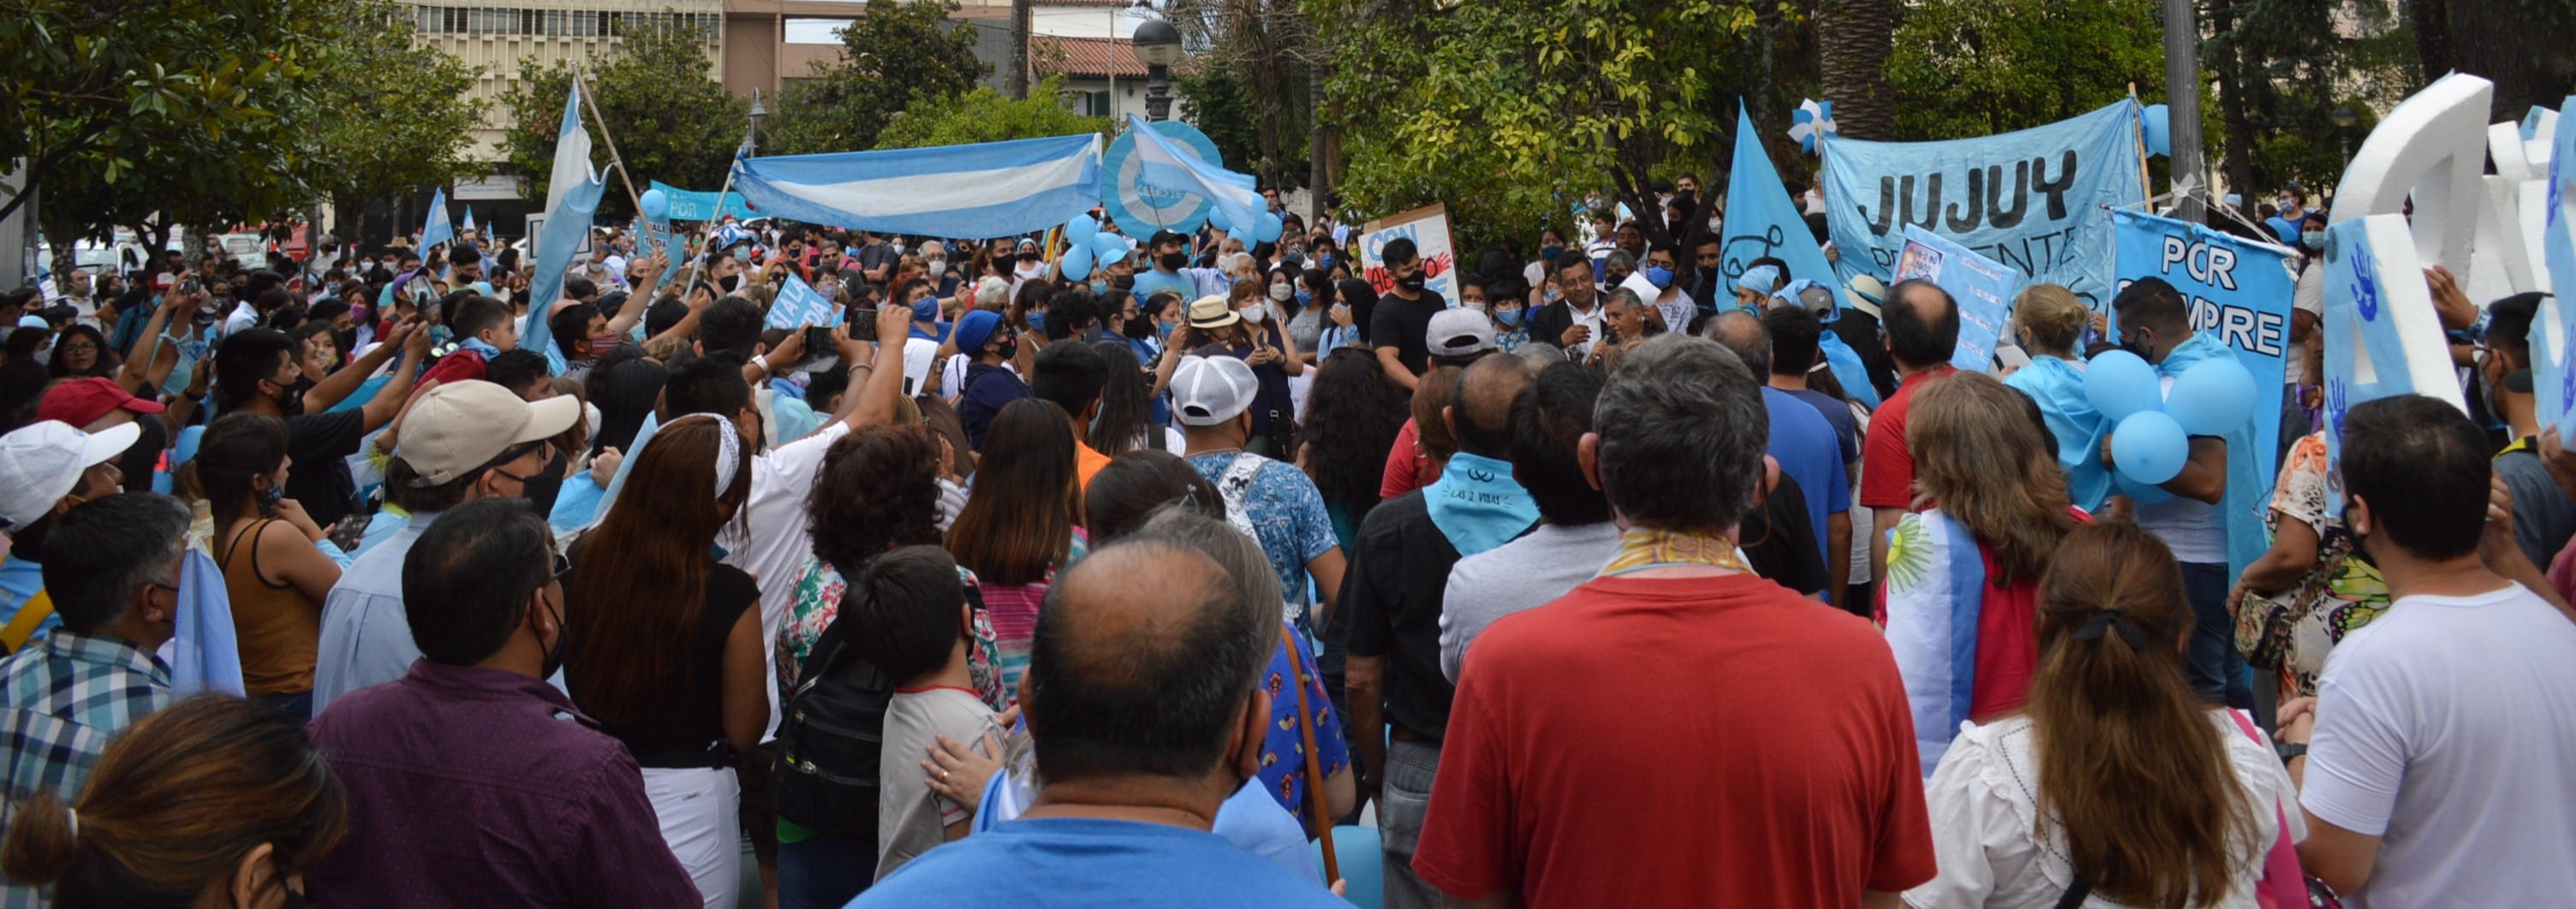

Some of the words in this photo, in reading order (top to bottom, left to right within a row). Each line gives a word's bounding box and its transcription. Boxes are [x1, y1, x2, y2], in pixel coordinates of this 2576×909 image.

[670, 202, 697, 217] POR
[1858, 149, 2077, 237] JUJUY
[2162, 234, 2238, 292] POR
[1451, 490, 1466, 500] LAS
[1469, 491, 1475, 502] 2
[1479, 492, 1500, 505] VIDAS
